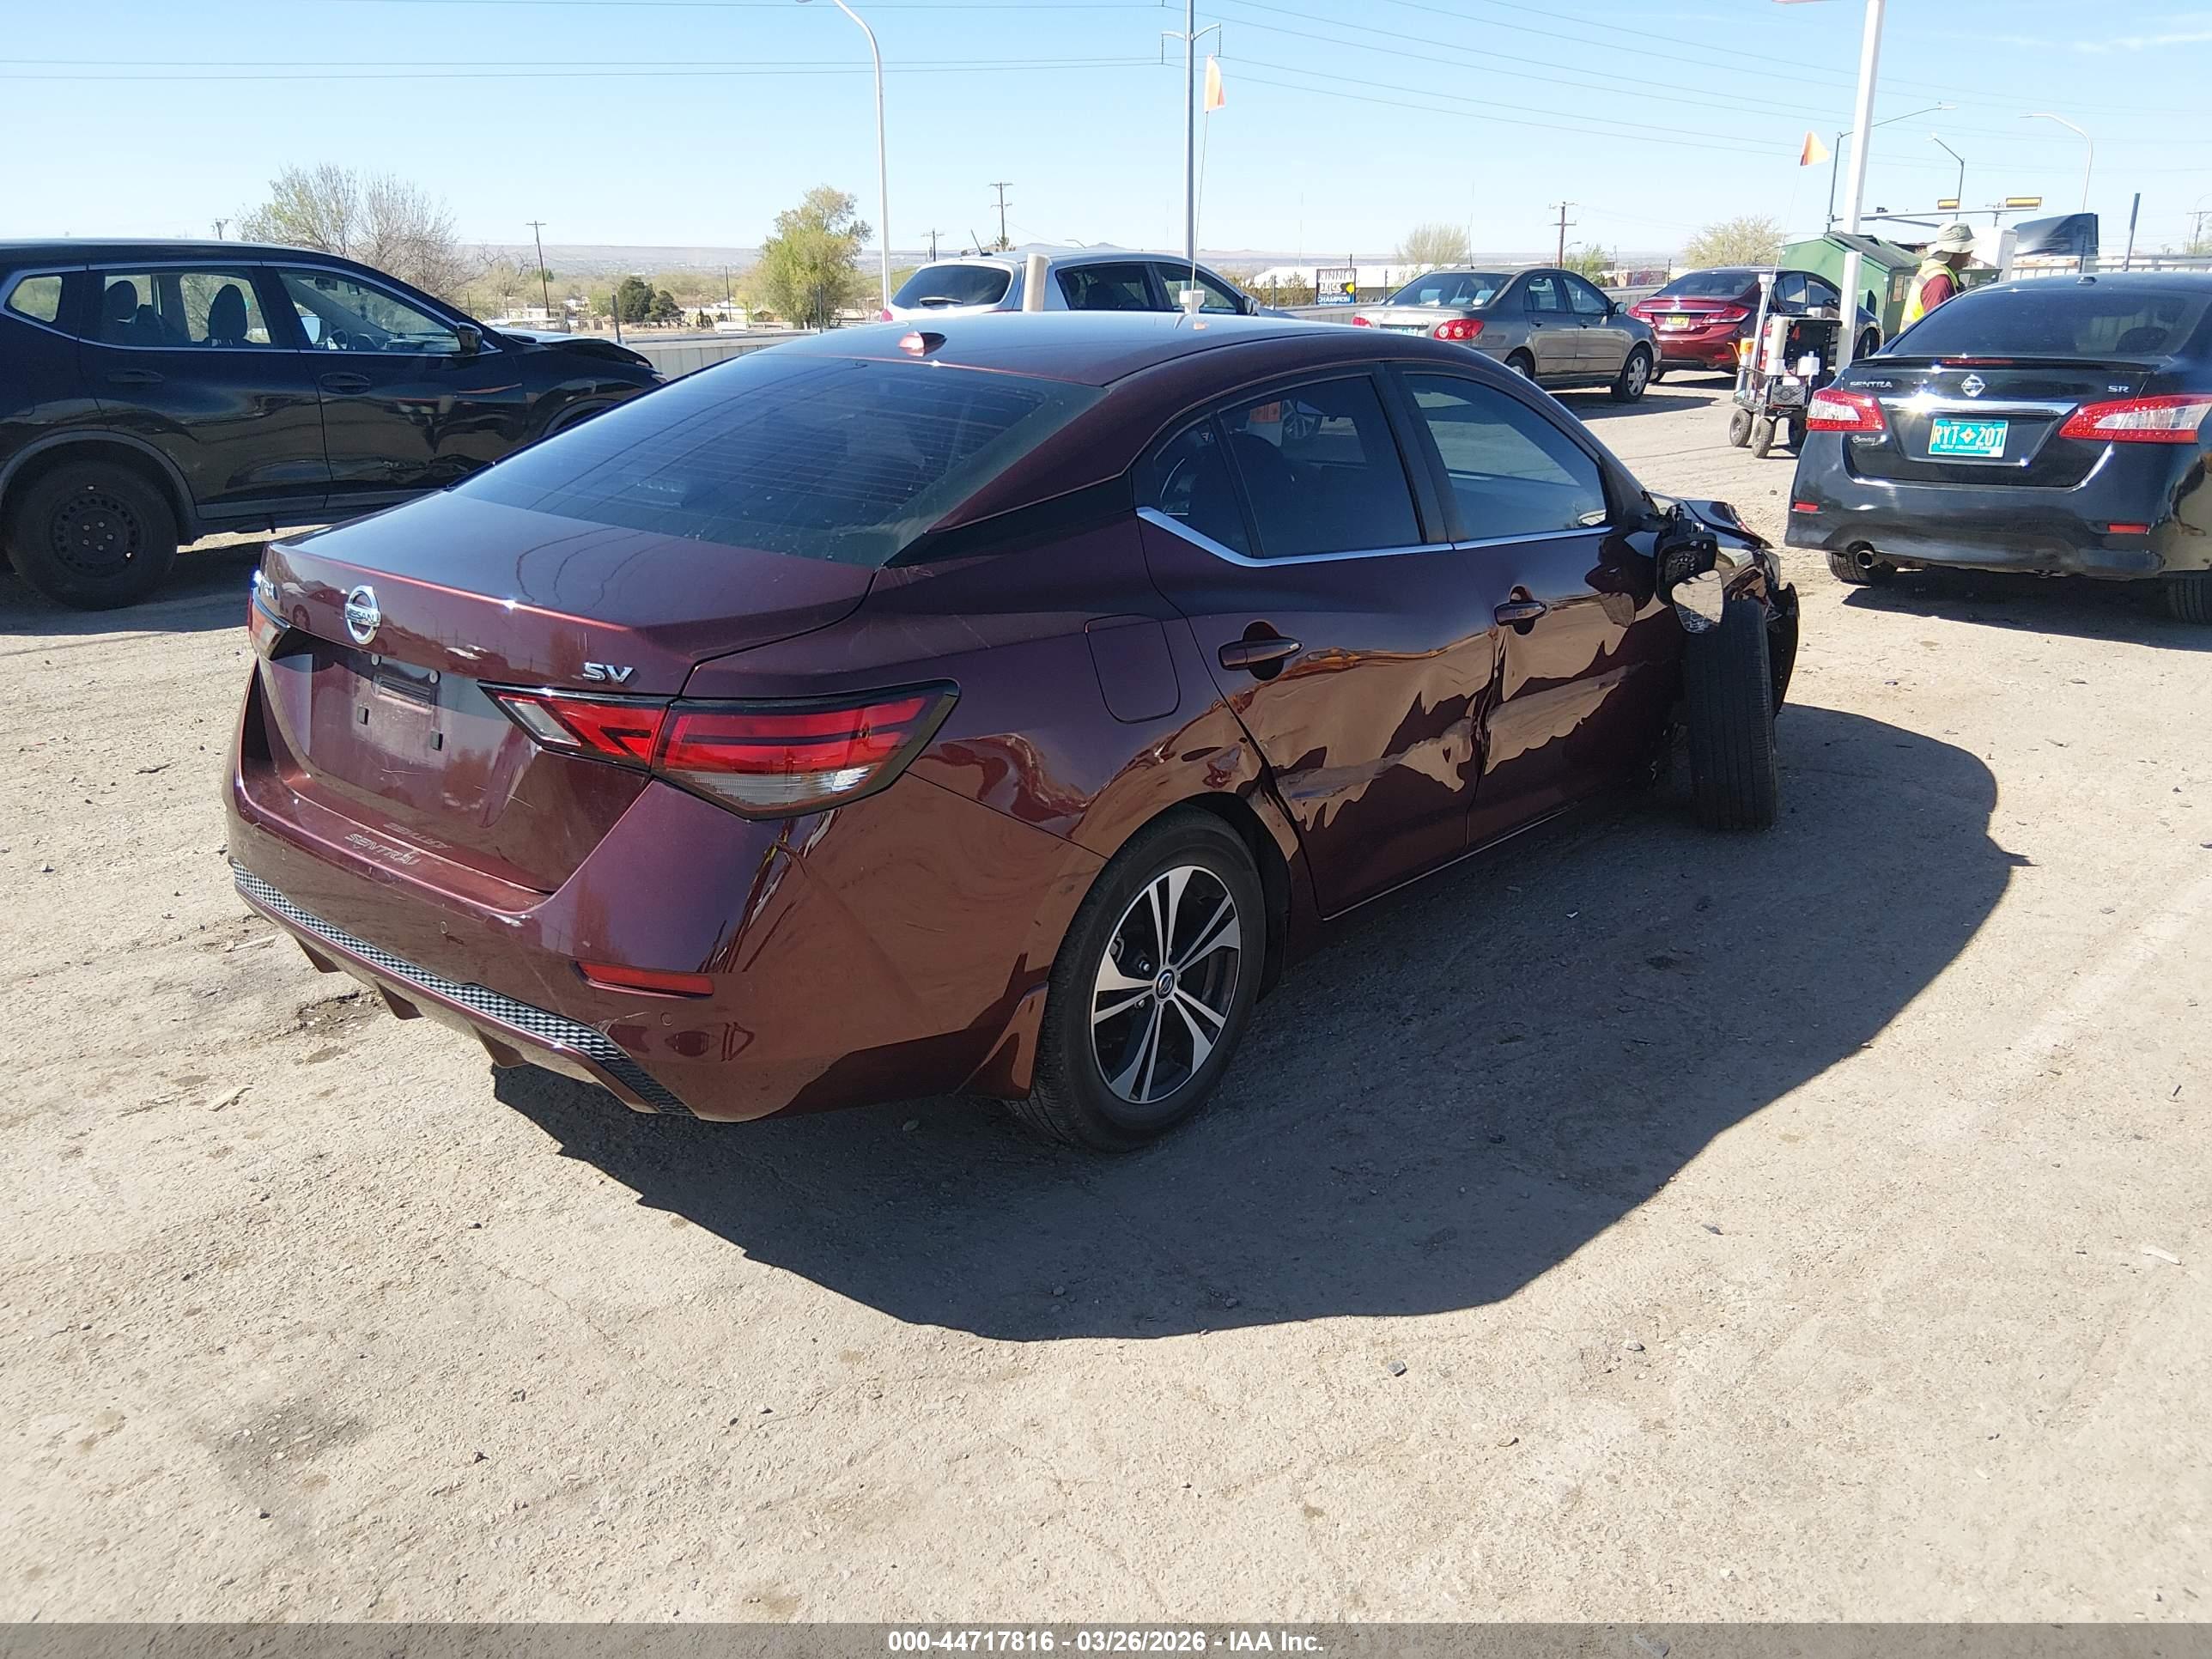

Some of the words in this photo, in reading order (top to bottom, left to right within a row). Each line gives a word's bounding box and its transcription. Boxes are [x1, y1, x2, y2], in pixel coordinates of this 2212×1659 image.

[1791, 325, 1801, 341] 4
[2107, 385, 2130, 393] SR
[1932, 426, 1960, 445] RYT
[1975, 427, 2005, 446] 207
[582, 662, 635, 684] SV
[344, 833, 416, 865] SENTRA
